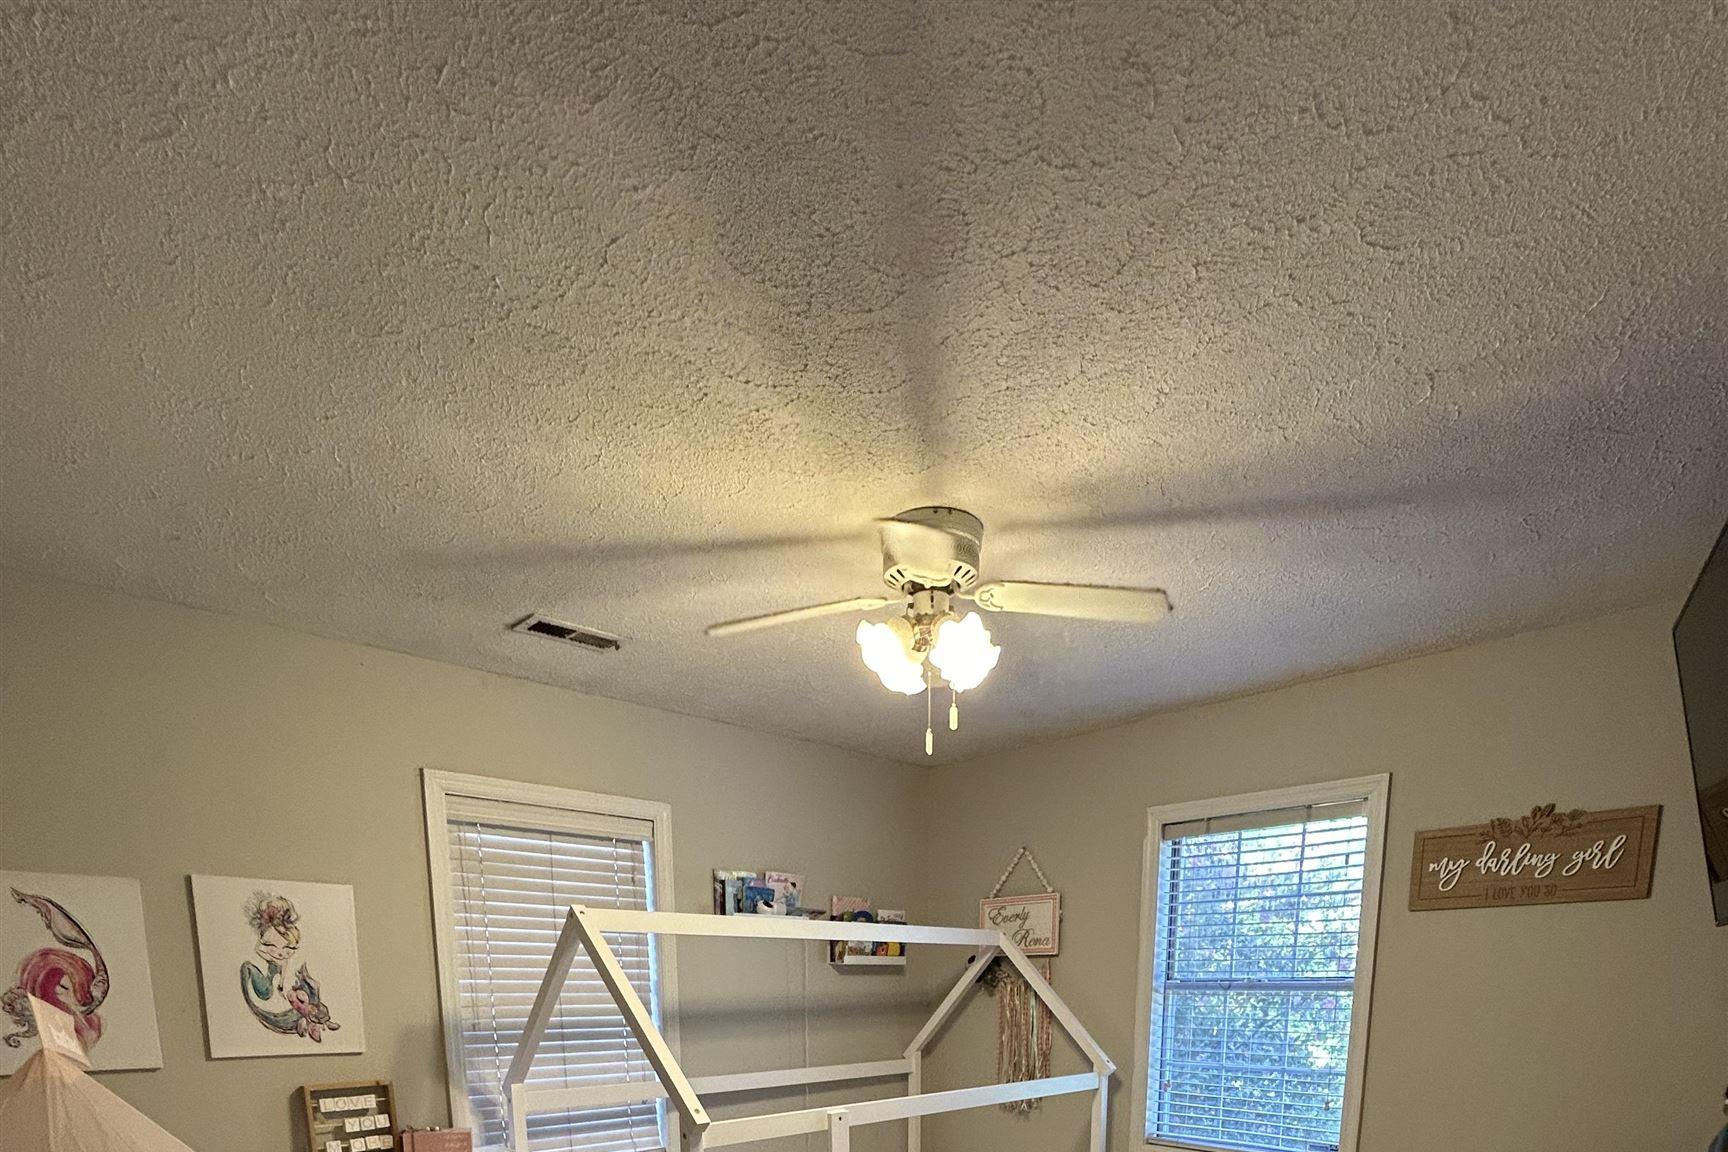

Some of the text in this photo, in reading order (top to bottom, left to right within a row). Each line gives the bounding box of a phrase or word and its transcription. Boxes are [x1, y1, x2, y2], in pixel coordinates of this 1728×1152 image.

[1428, 834, 1628, 892] my darling girl
[1492, 886, 1516, 901] LOVE
[1518, 884, 1541, 899] YOU
[988, 906, 1031, 929] Everly
